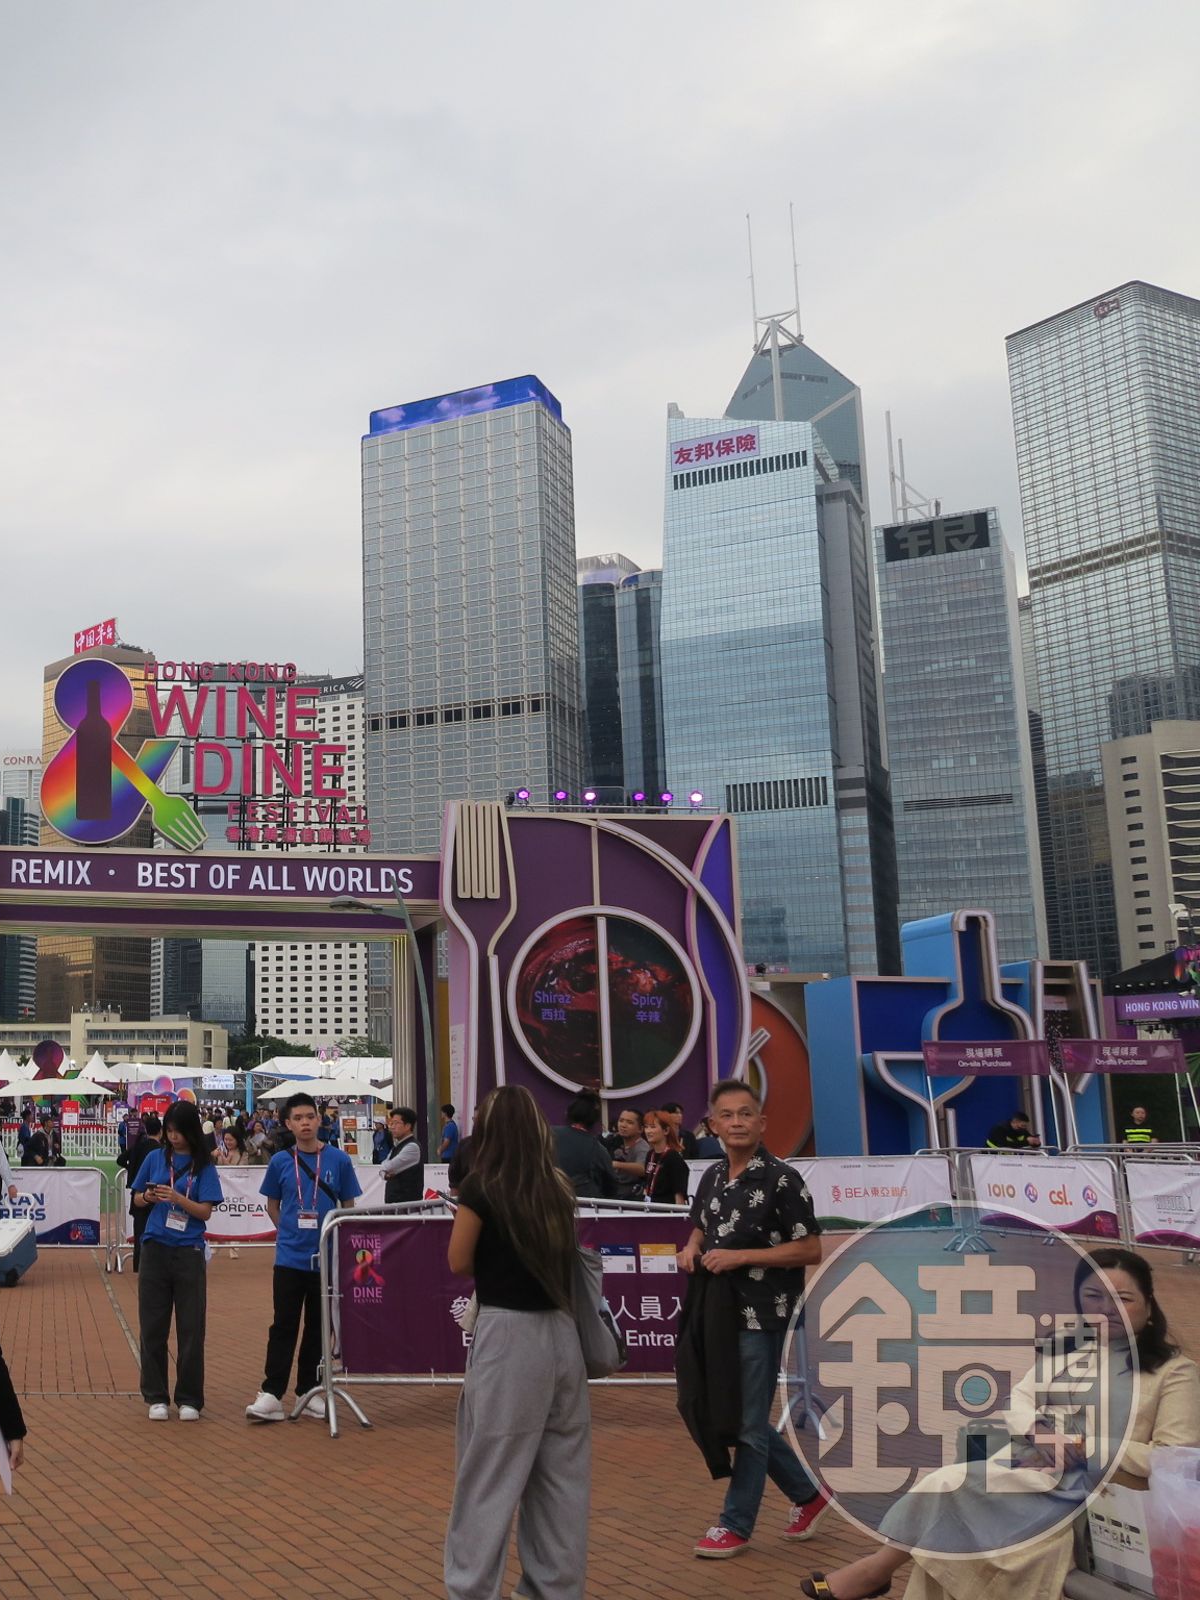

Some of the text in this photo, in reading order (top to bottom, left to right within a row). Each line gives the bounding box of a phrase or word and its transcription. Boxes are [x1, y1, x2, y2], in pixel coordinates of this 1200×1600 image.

[673, 432, 757, 466] 友邦保險
[144, 661, 297, 682] HONG KONG
[145, 684, 321, 740] WINE
[3, 755, 42, 766] CONRA
[193, 741, 347, 799] DINE
[227, 801, 370, 824] FESTIVAL
[10, 858, 414, 894] REMIX BEST OF ALL WORLDS
[534, 990, 572, 1005] Shiraz
[631, 992, 663, 1007] Spicy
[1125, 1001, 1150, 1012] HONG
[1152, 1000, 1178, 1012] KONG
[541, 1008, 567, 1021] 西拉
[635, 1010, 662, 1023] 辛辣
[845, 1187, 870, 1199] BEA
[351, 1238, 382, 1249] WINE
[353, 1286, 383, 1298] DINE
[625, 1329, 678, 1347] Entra
